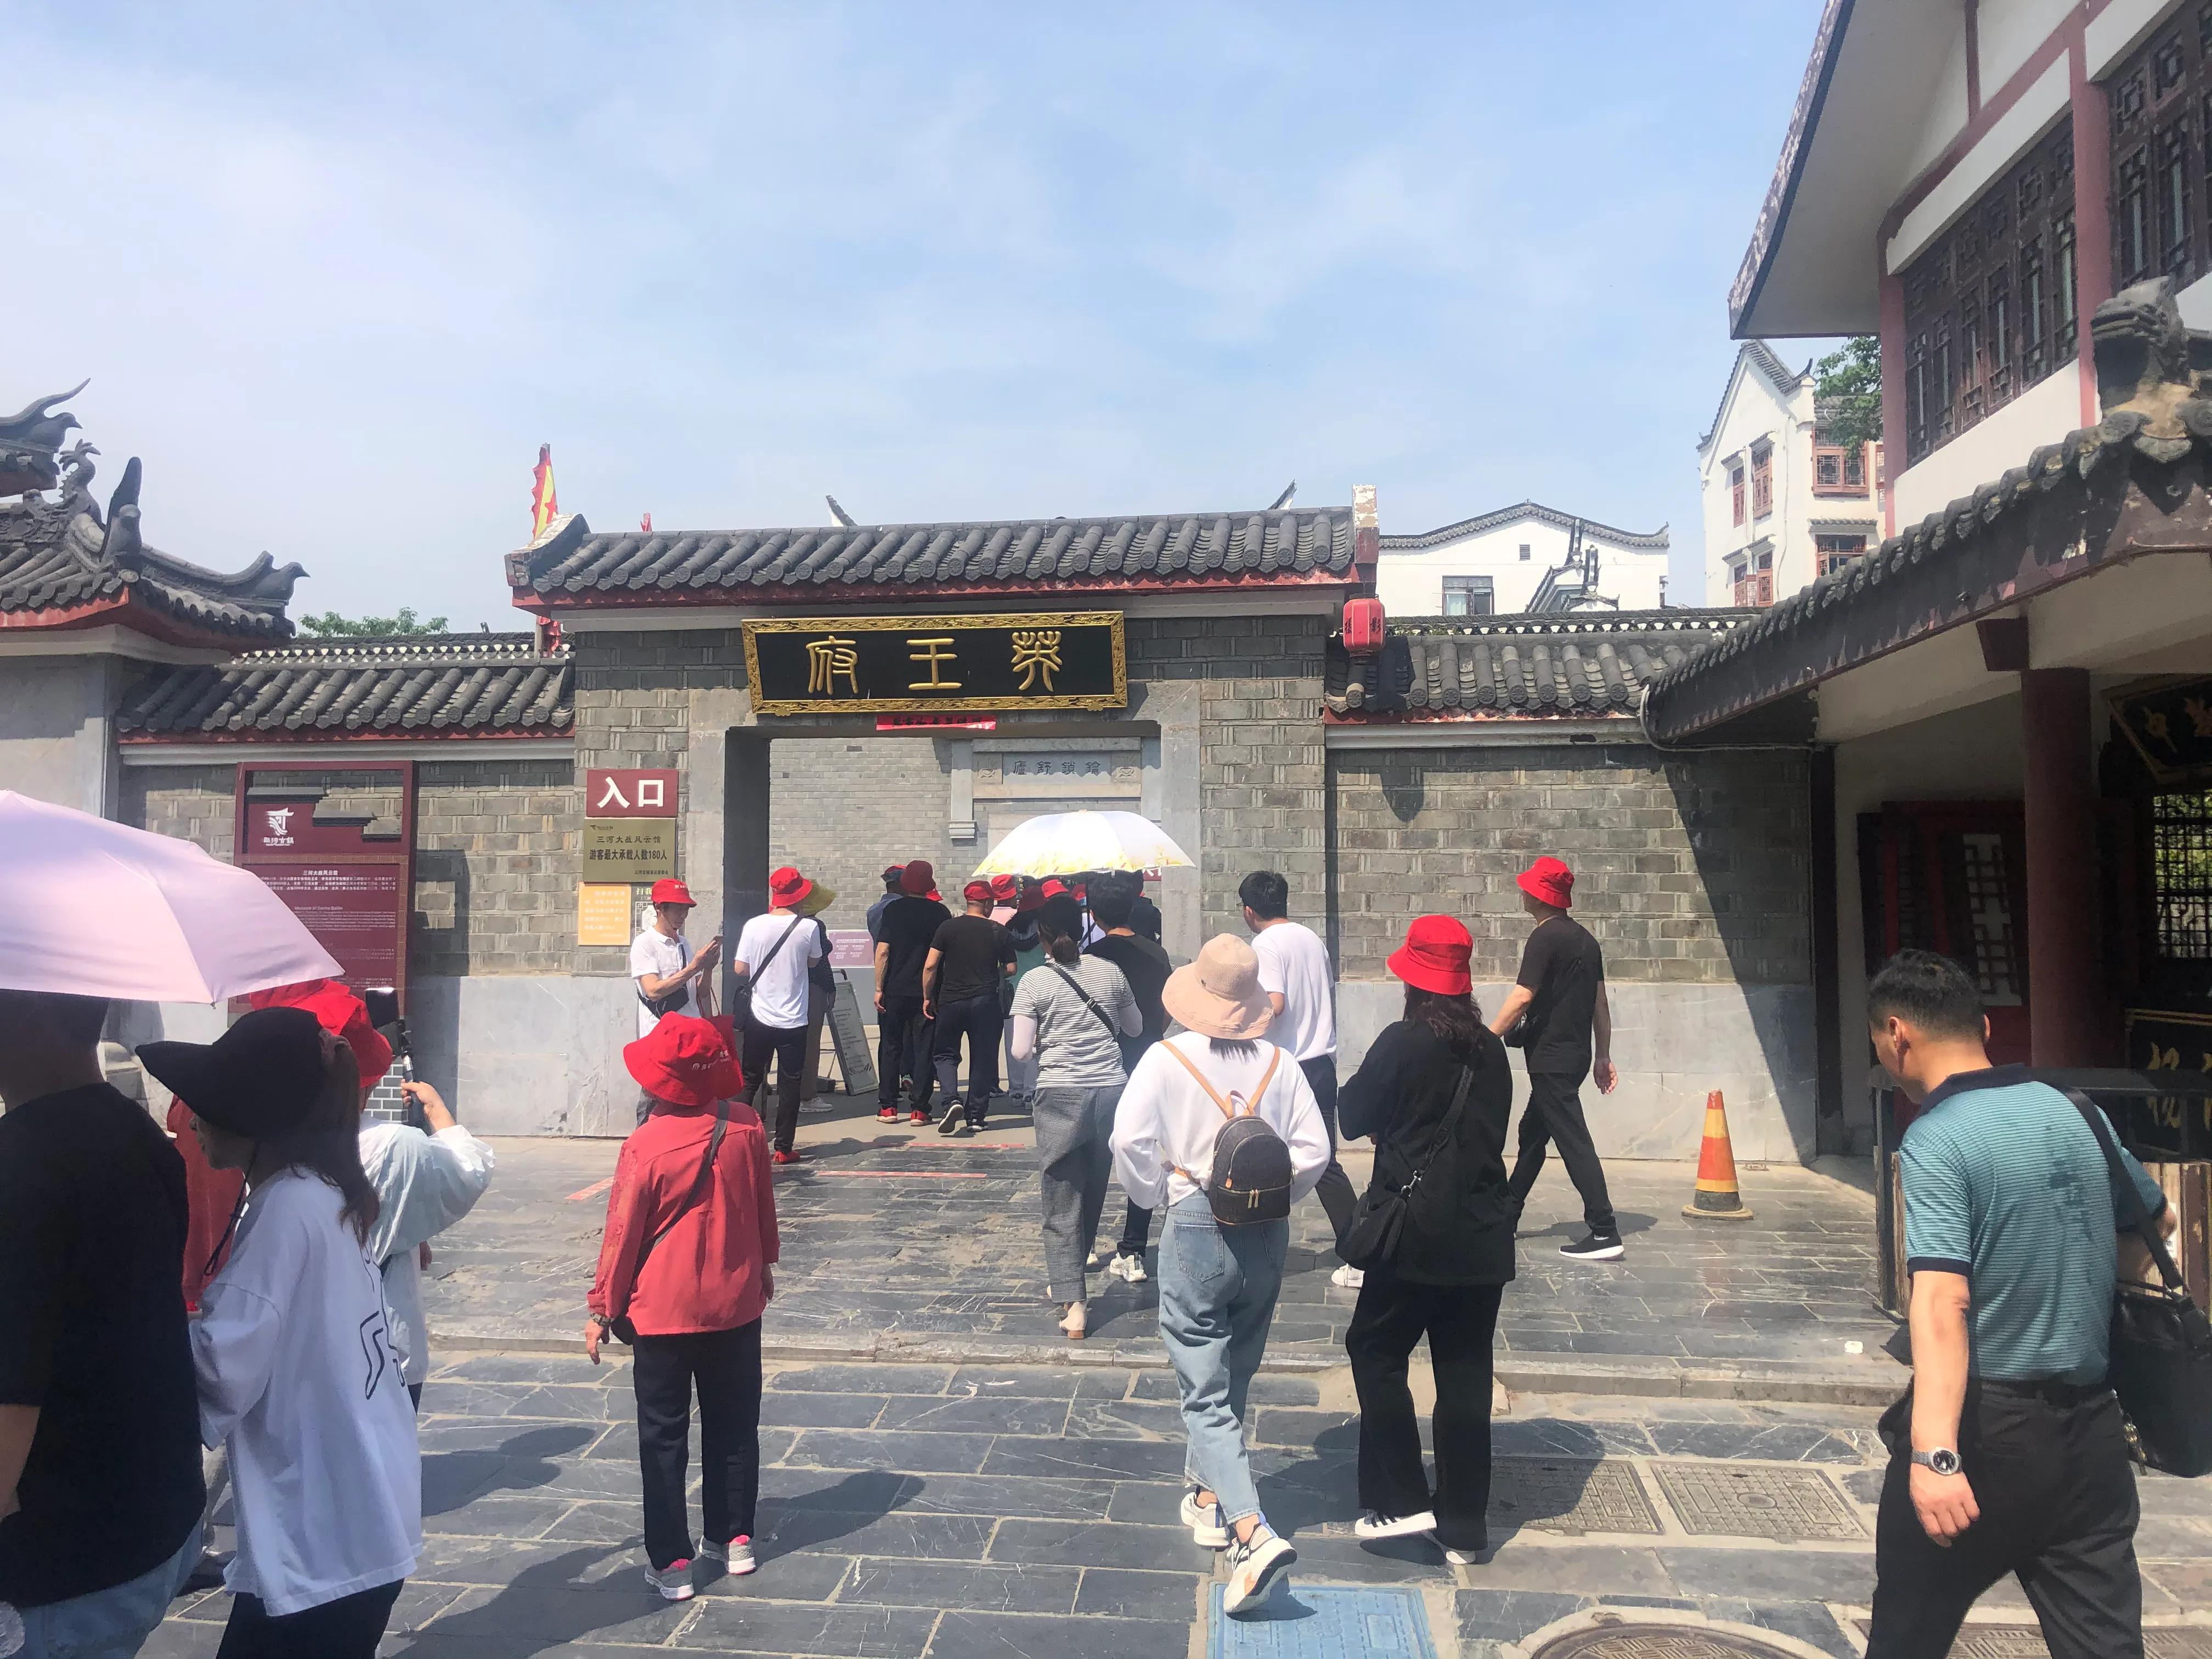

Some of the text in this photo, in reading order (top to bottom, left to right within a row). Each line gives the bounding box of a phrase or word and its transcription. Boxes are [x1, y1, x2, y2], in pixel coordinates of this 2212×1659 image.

[597, 776, 664, 809] 入口
[596, 836, 662, 844] 三河大战风云馆
[589, 849, 668, 861] 游客最大承载人数180人
